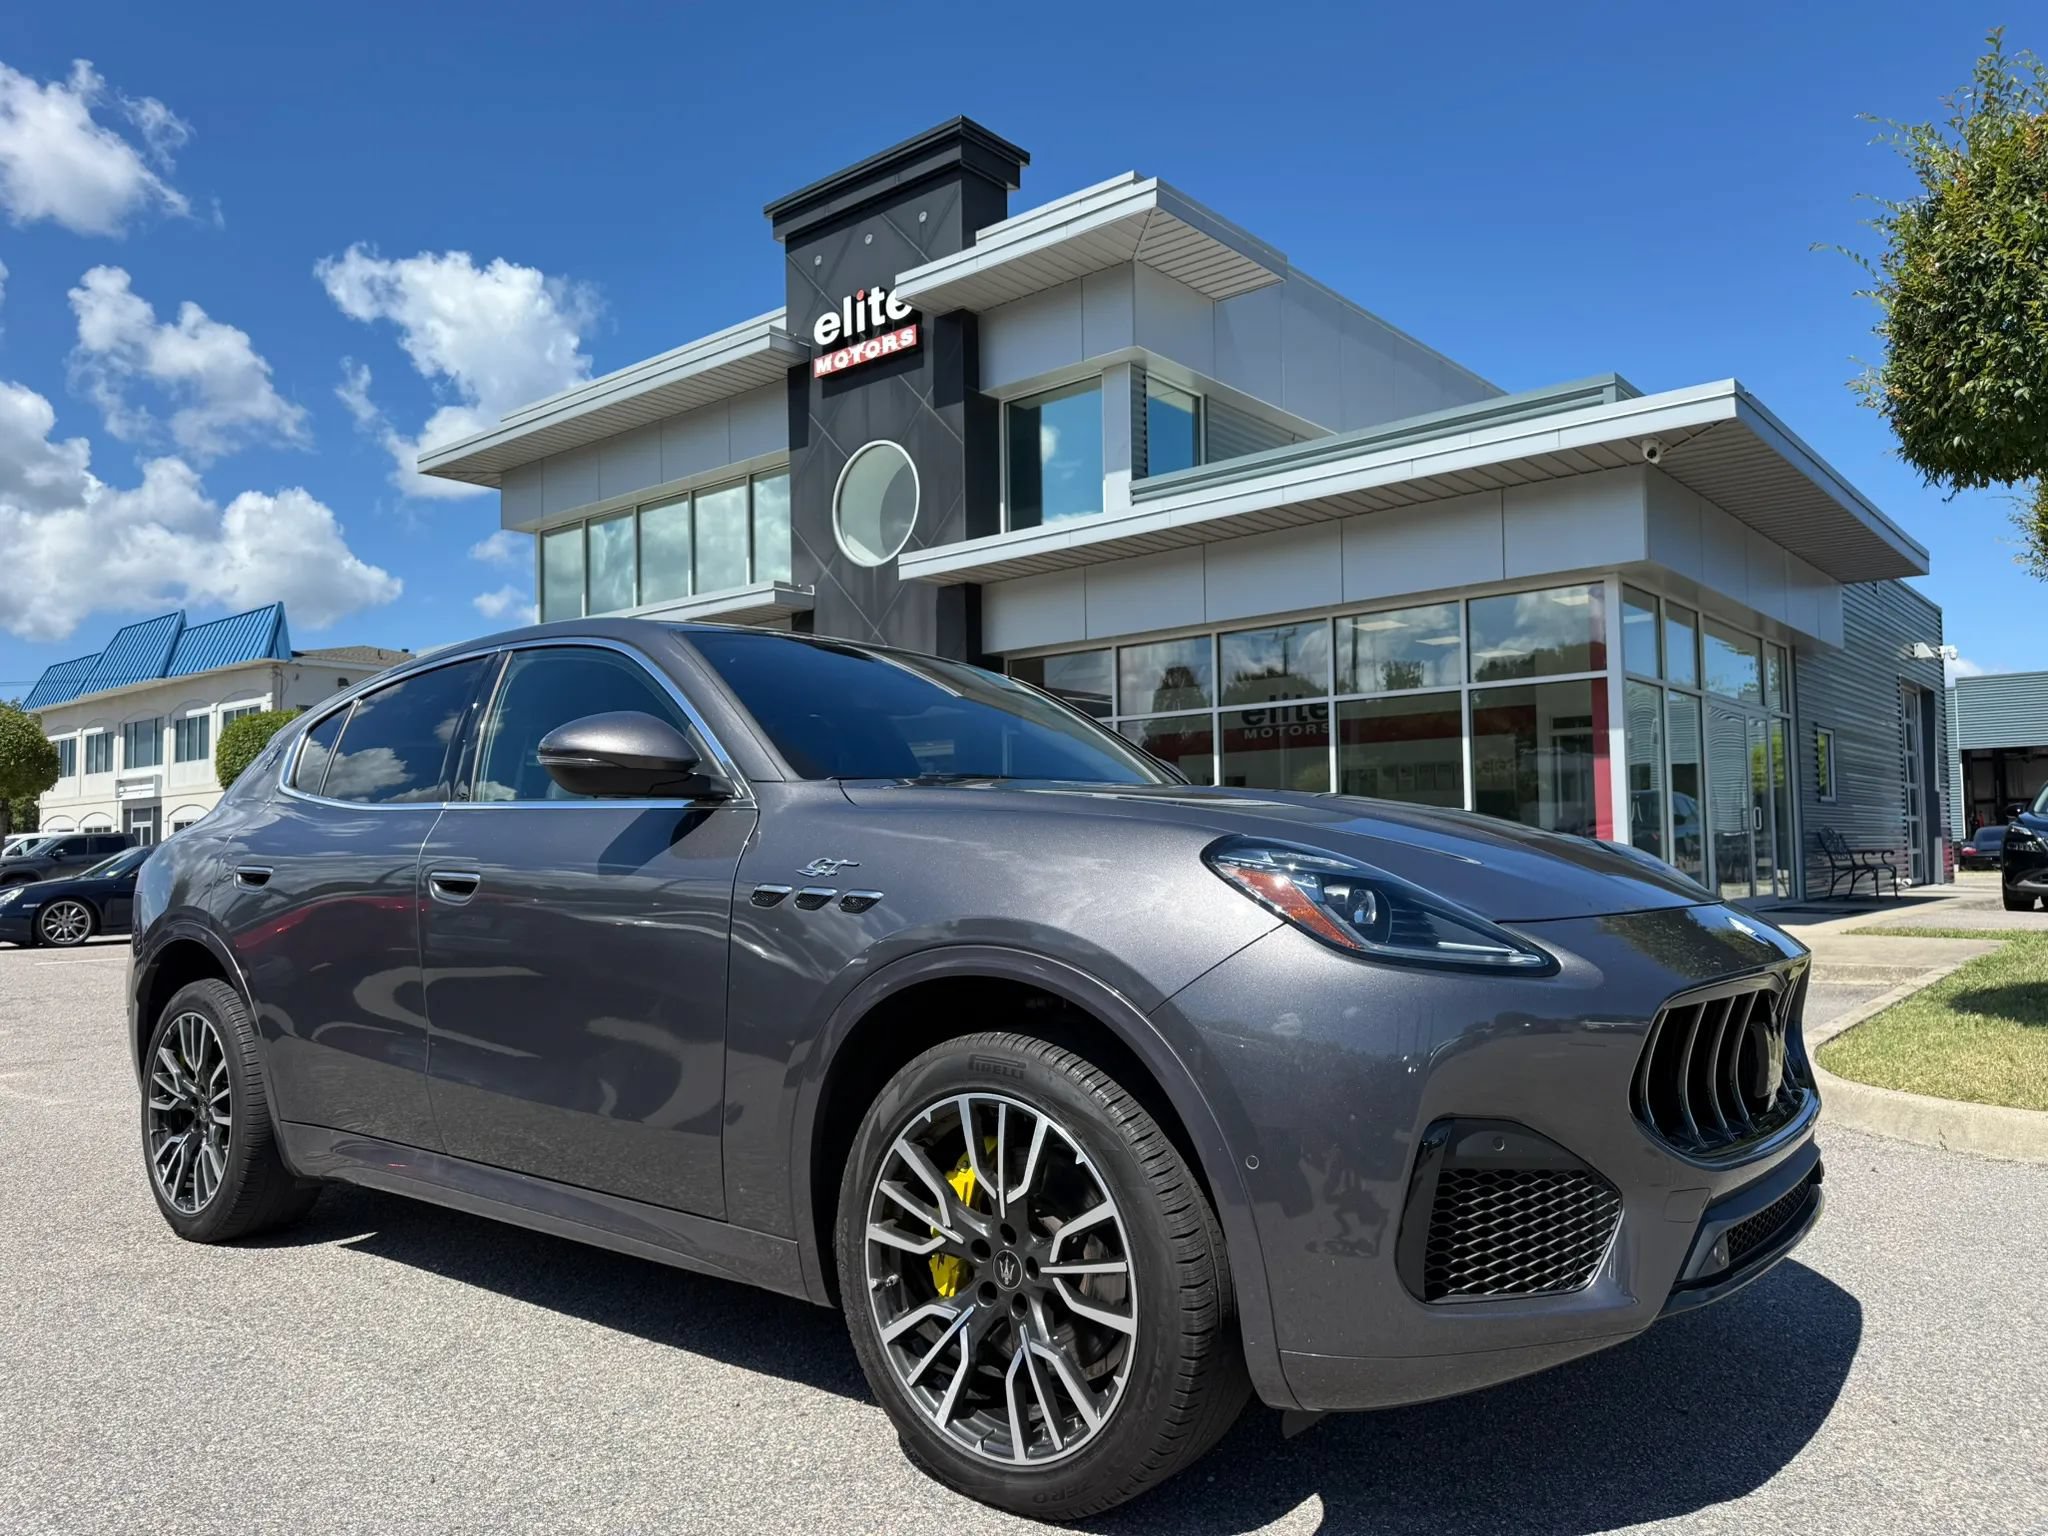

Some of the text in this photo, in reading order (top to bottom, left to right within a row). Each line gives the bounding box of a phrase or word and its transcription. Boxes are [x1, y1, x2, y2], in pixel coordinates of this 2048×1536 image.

[815, 328, 914, 374] MOTORS
[1243, 722, 1329, 740] MOTORS
[968, 1054, 1027, 1080] PIRELLI
